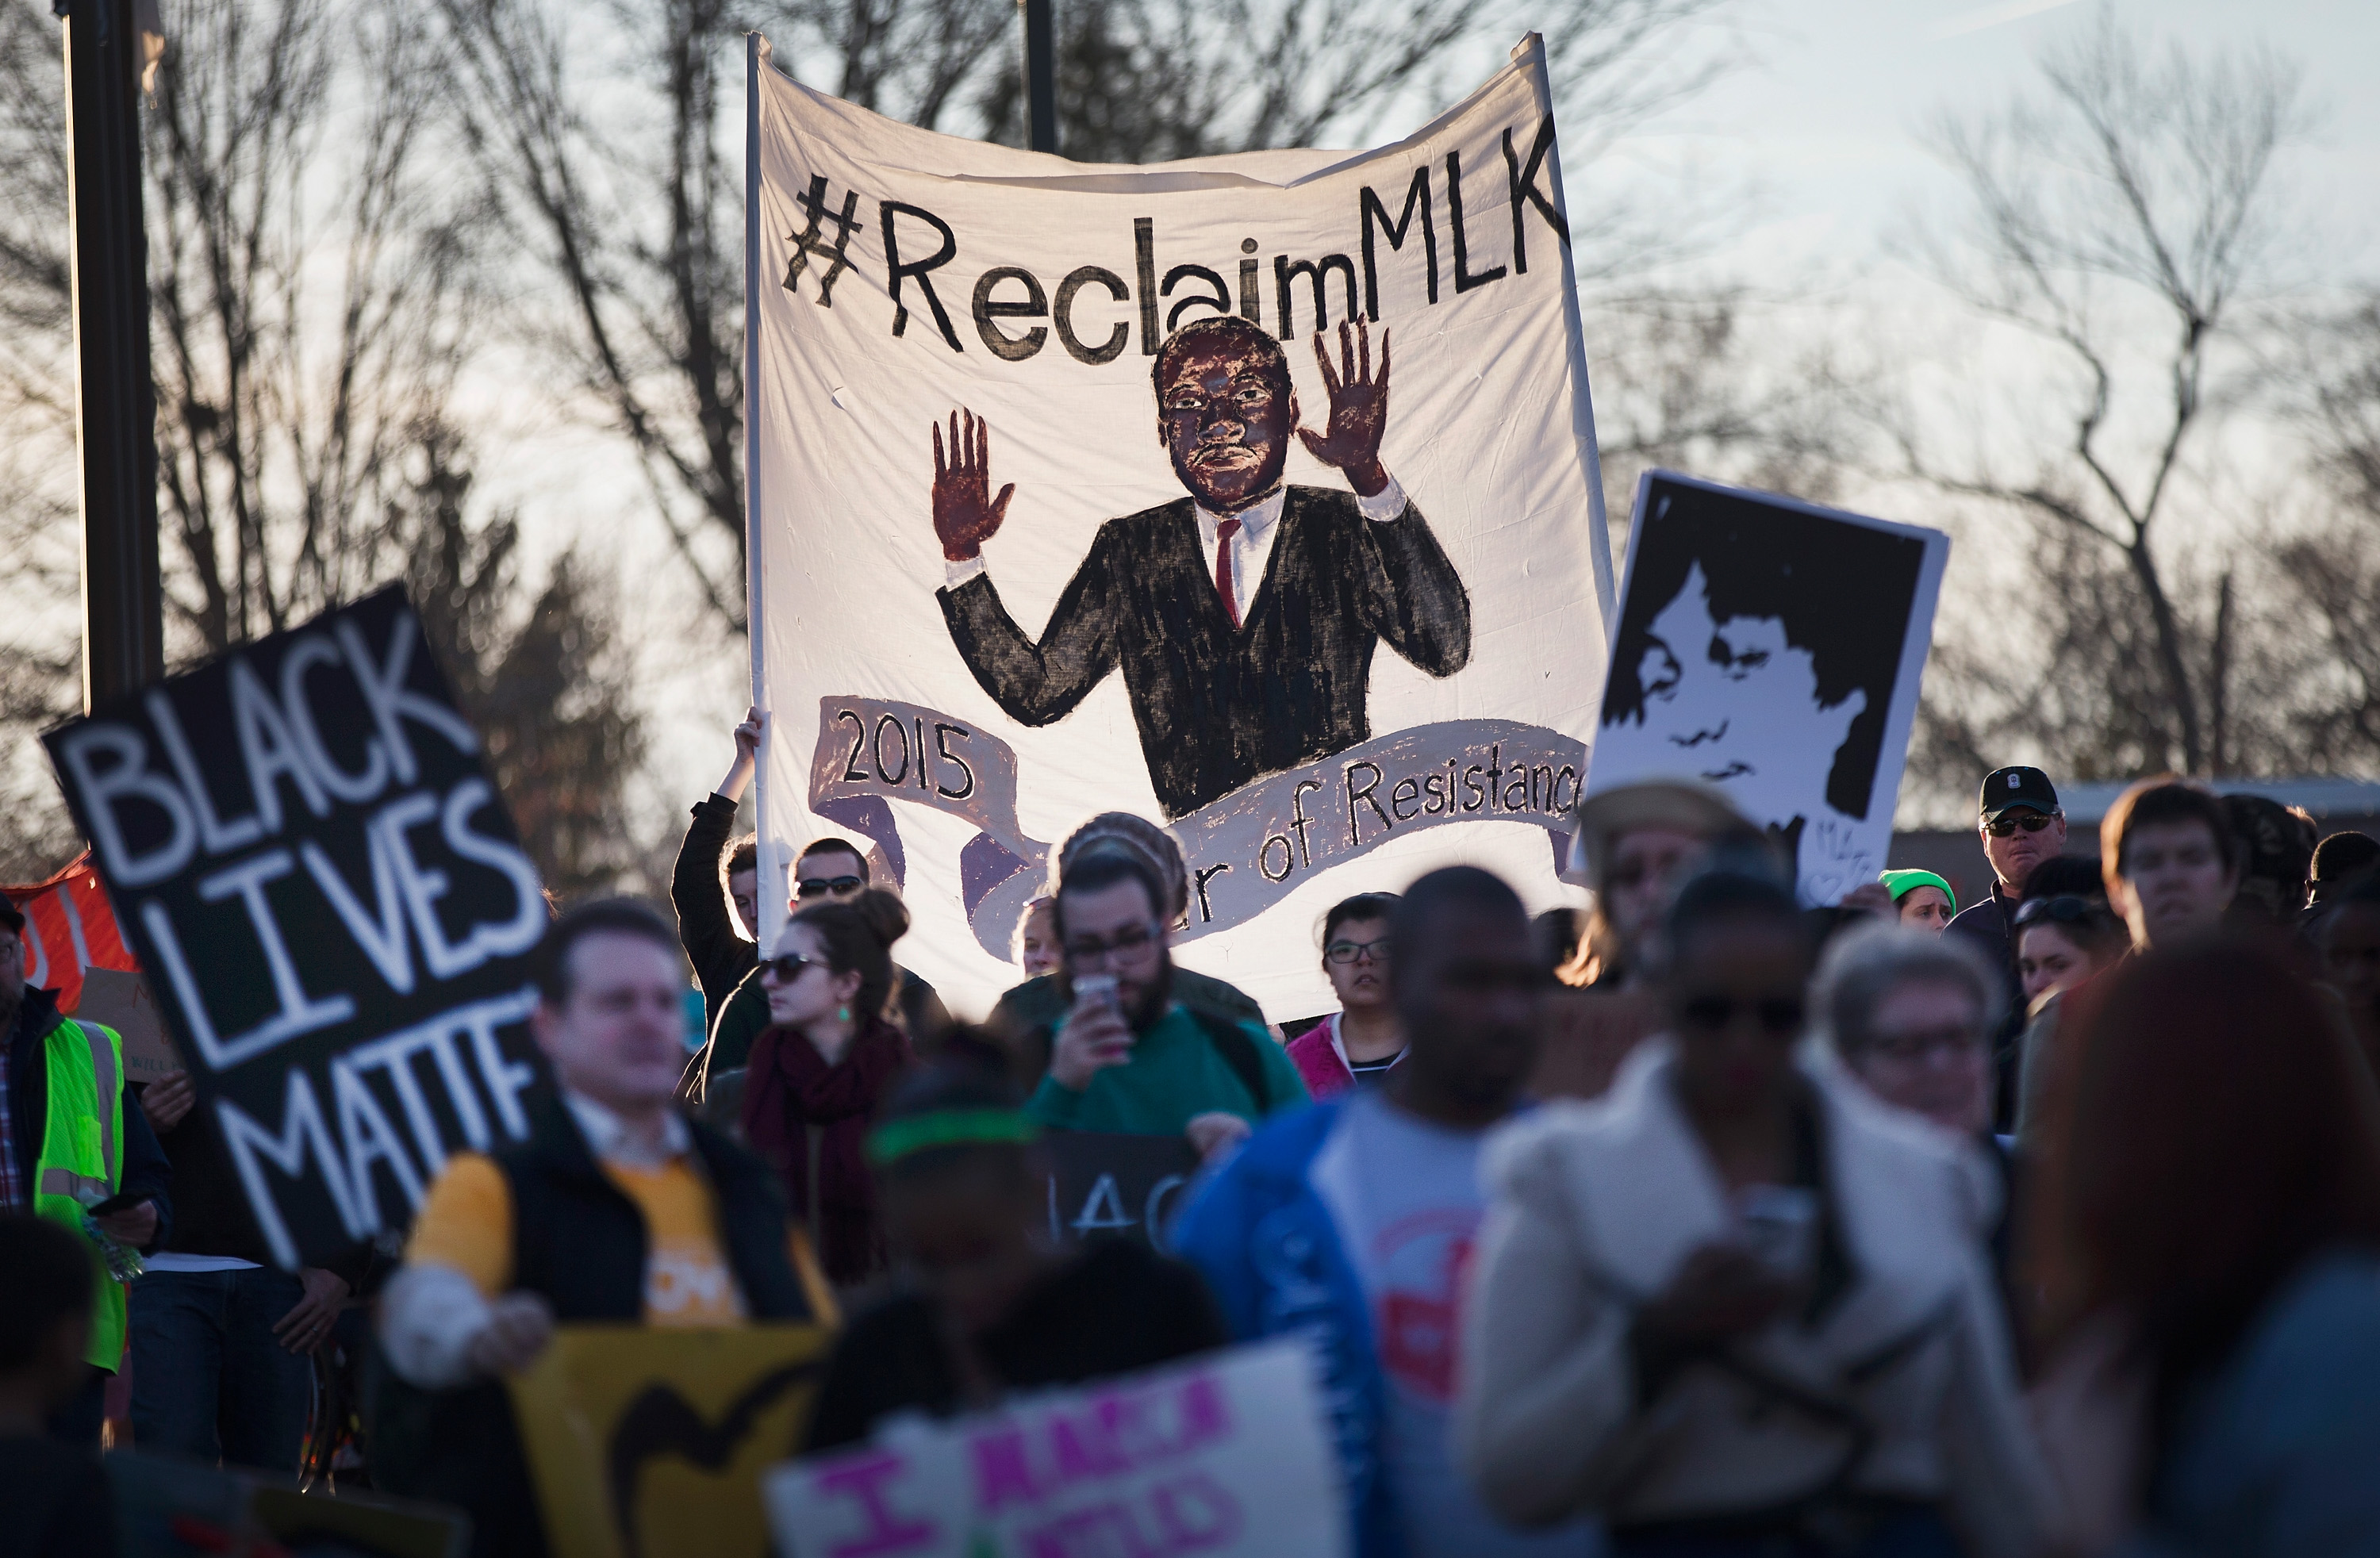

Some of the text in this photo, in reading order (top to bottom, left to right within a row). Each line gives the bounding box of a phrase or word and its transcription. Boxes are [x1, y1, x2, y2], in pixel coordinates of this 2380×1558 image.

[63, 611, 481, 888] BLACK
[837, 709, 974, 800] 2015
[1258, 780, 1322, 883] of
[141, 777, 549, 1071] LIVES
